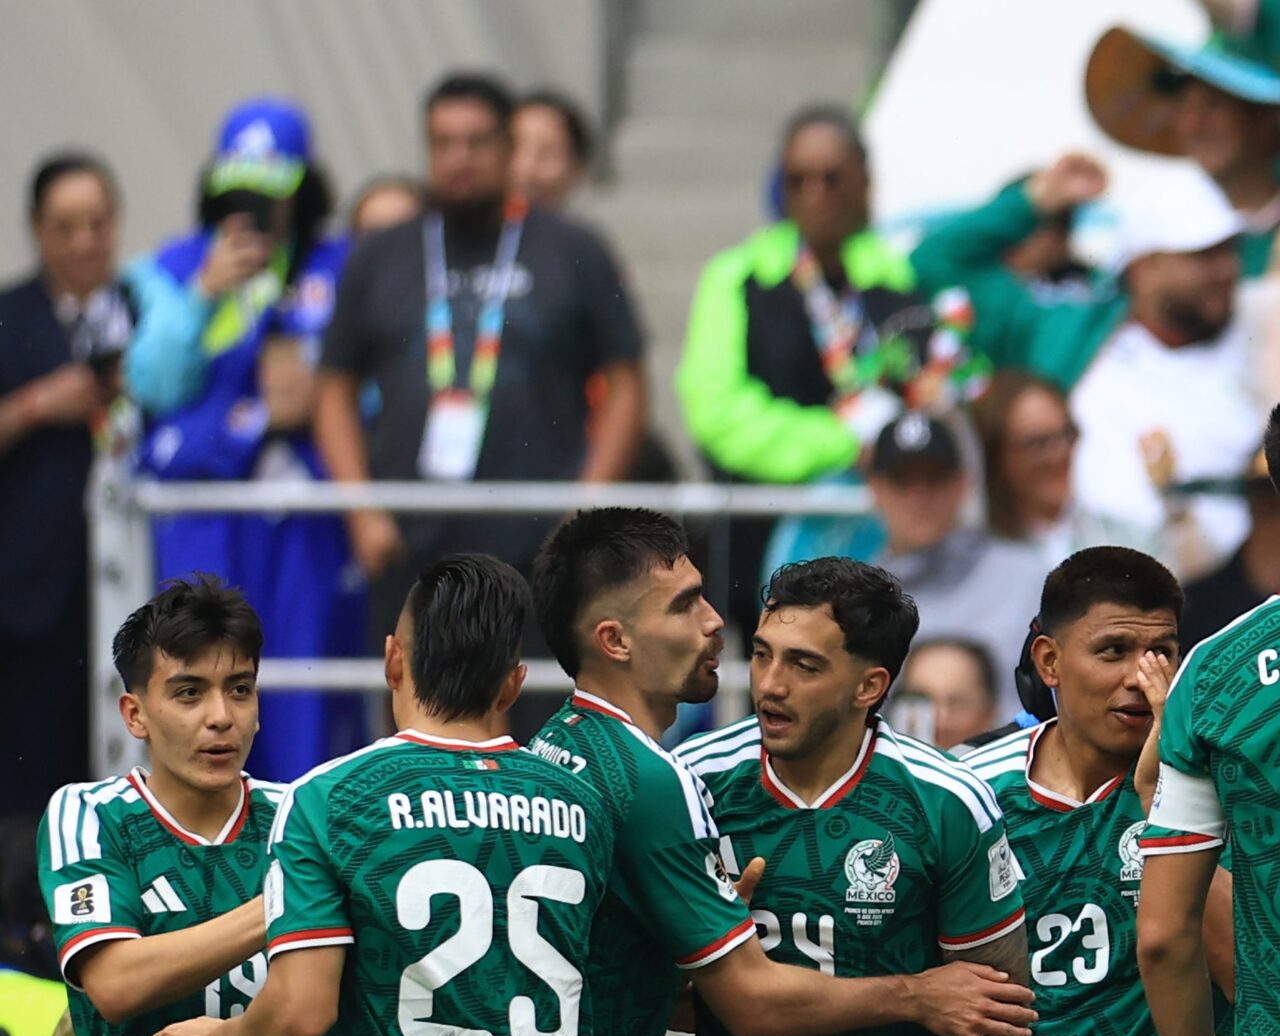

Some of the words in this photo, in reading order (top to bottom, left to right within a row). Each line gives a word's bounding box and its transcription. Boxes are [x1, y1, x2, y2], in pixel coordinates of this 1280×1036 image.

[387, 790, 586, 843] R.ALVARADO
[847, 889, 894, 901] MÉXICO
[1031, 903, 1110, 986] 23
